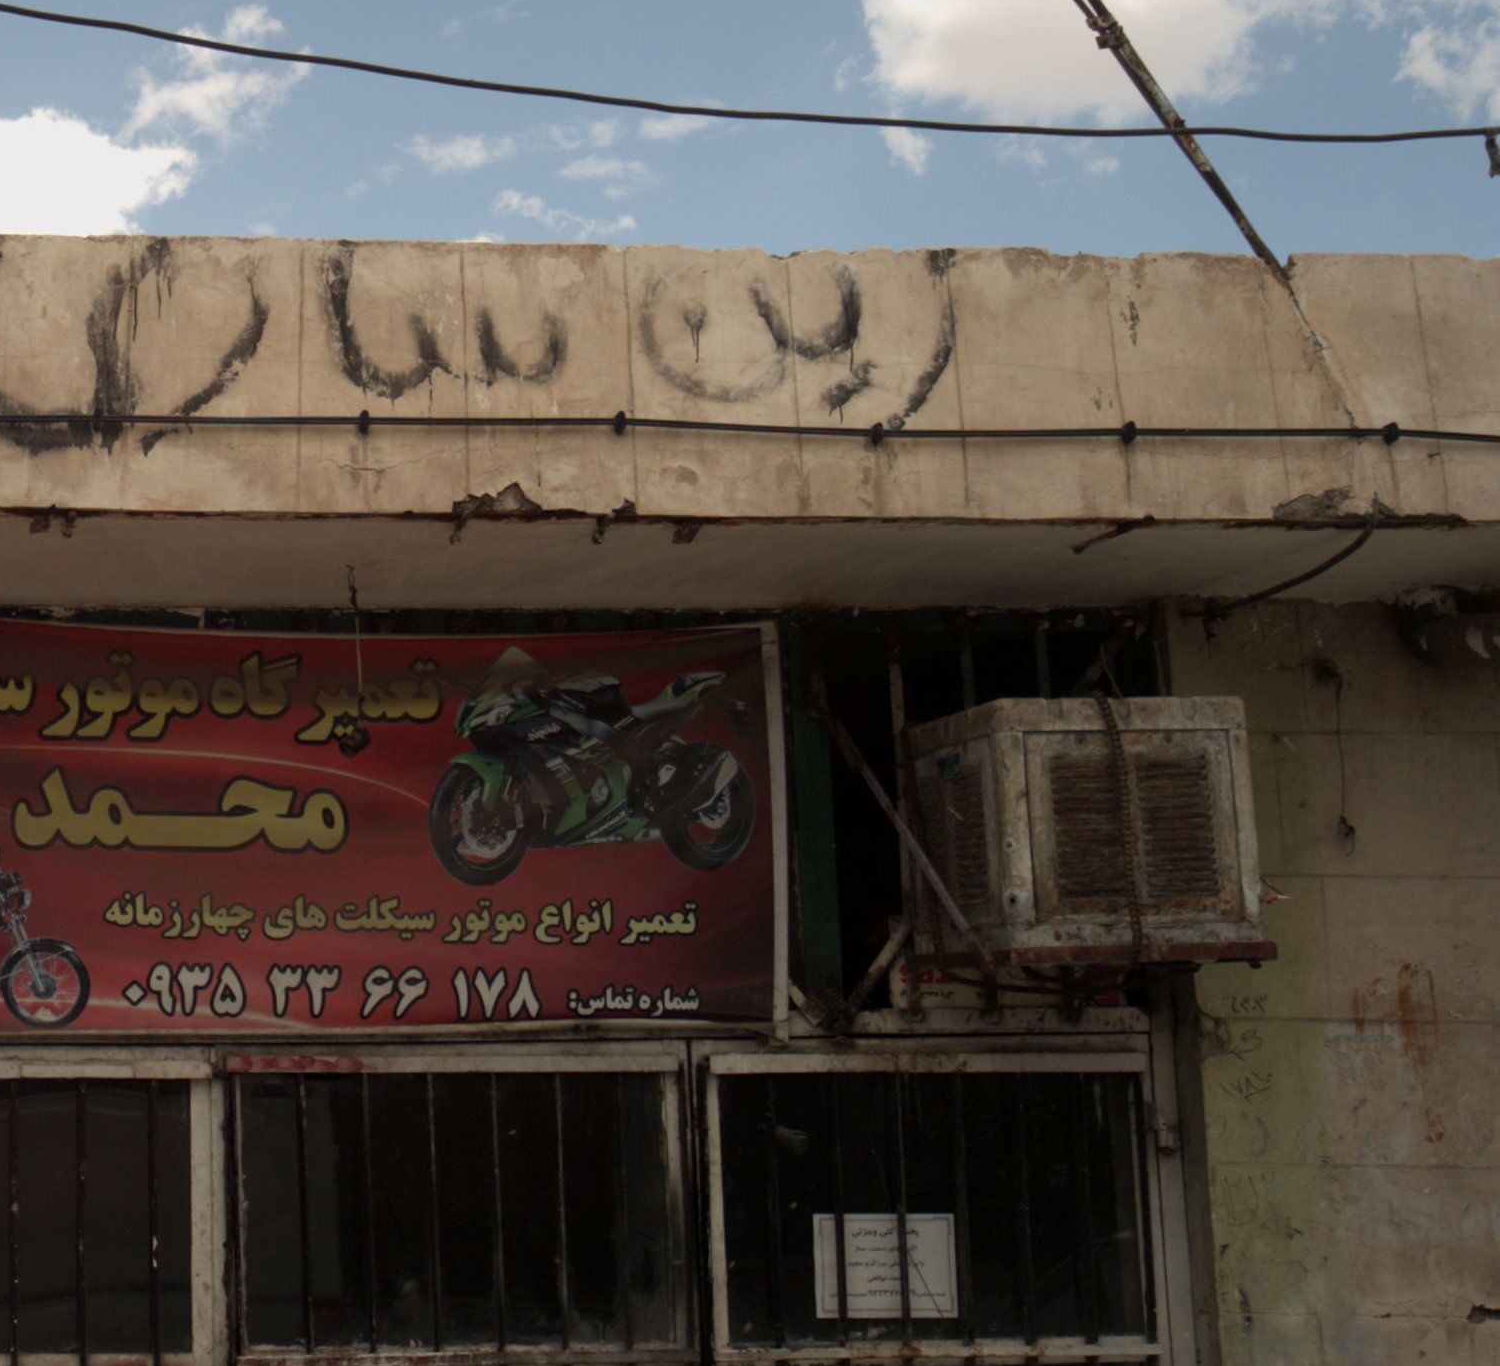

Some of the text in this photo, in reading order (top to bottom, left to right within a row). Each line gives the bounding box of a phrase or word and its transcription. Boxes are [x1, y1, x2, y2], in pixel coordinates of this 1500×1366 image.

[39, 651, 201, 741] موتور
[209, 650, 301, 719] گاه
[296, 657, 443, 744] تعمیر
[262, 893, 328, 940] های
[334, 894, 436, 939] سیکلت
[442, 897, 527, 944] موتور
[534, 898, 613, 945] انواع
[619, 901, 698, 945] تعمیر
[122, 962, 247, 1018] ۰۹۳۵
[267, 962, 342, 1019] ۳۳
[361, 965, 428, 1020] ۶۶
[452, 966, 542, 1020] ۱۷۸
[637, 985, 700, 1017] شماره
